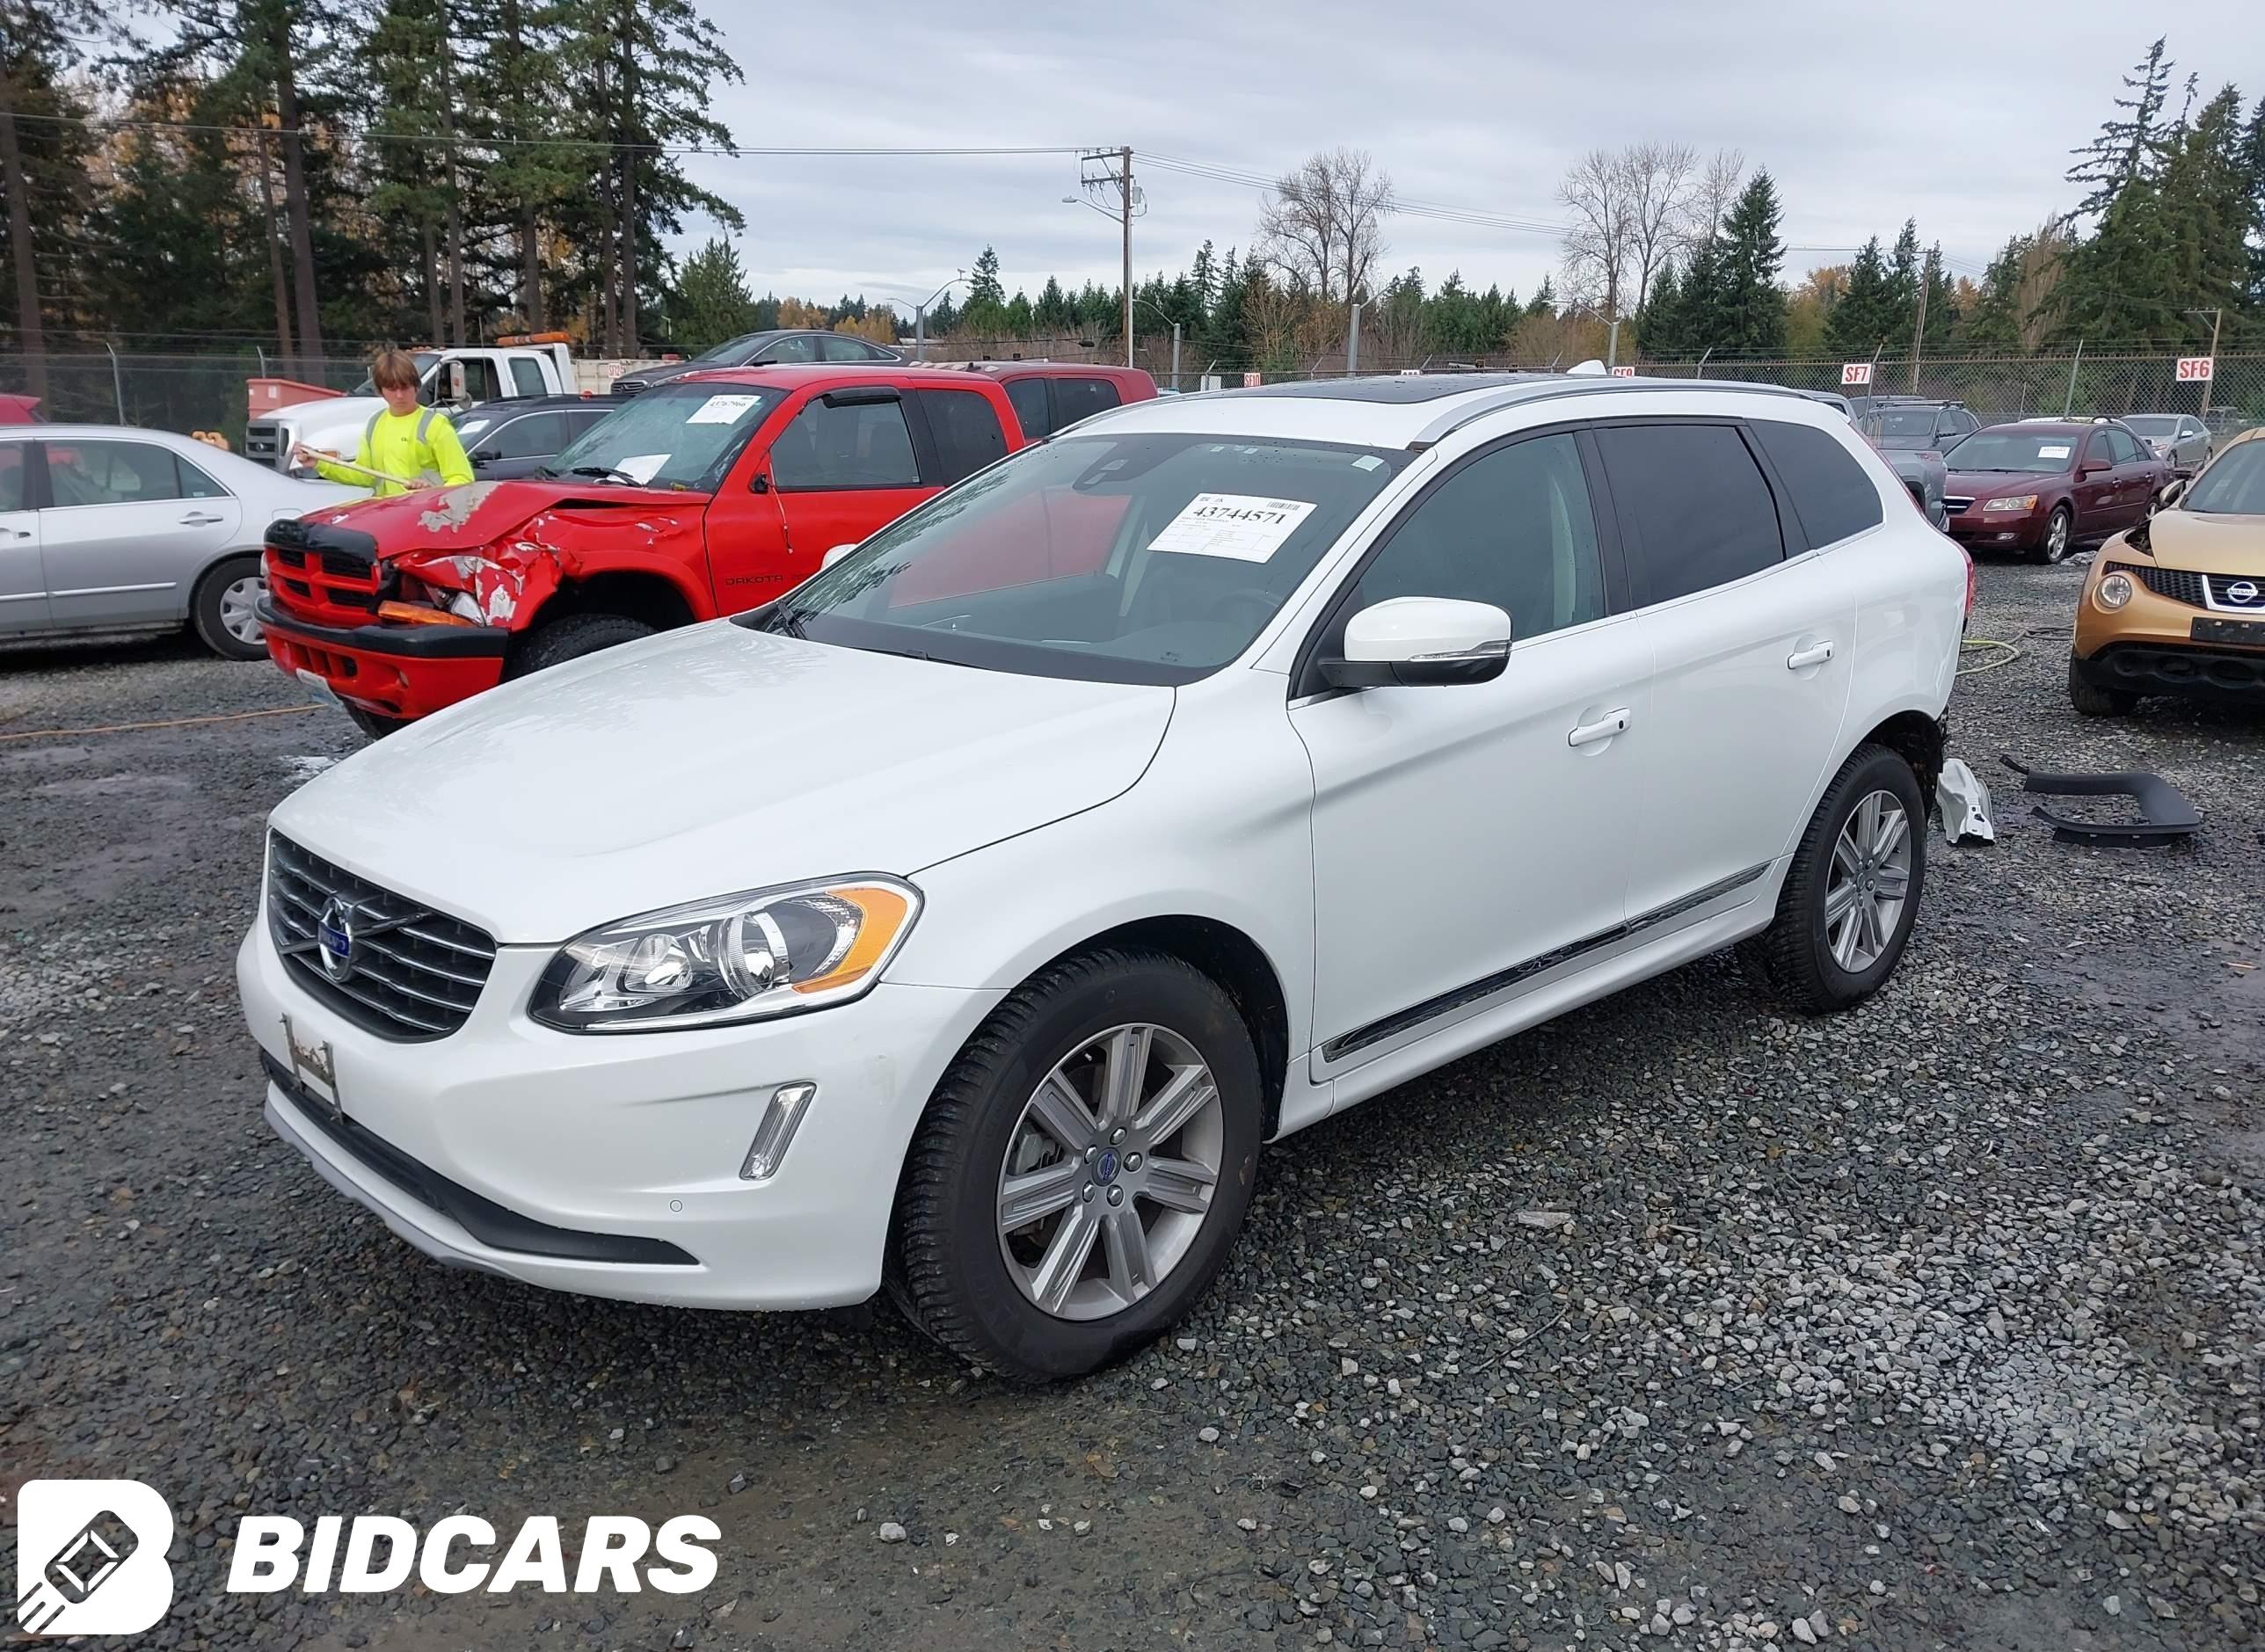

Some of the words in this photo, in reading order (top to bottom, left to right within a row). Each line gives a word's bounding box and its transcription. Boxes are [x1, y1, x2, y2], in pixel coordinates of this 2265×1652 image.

[1846, 366, 1868, 382] SF7
[2180, 360, 2210, 378] SF6
[1193, 506, 1287, 524] 43744571
[725, 575, 783, 586] DAKOTA
